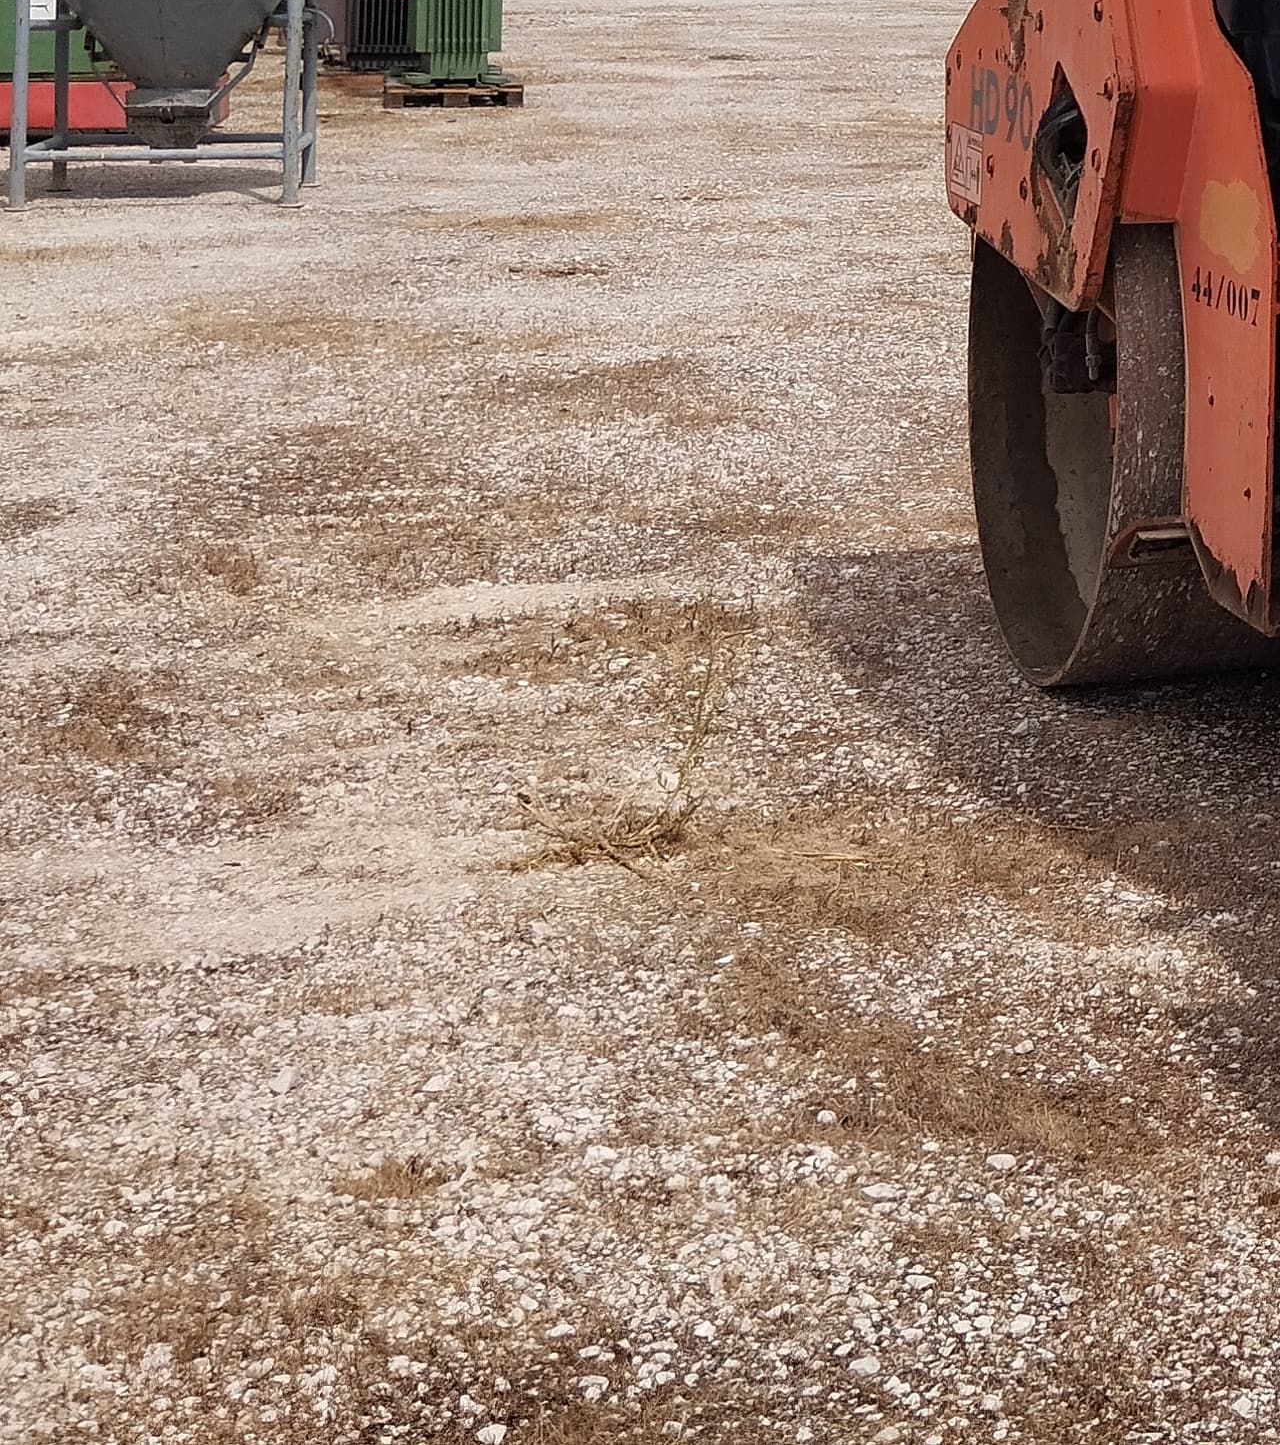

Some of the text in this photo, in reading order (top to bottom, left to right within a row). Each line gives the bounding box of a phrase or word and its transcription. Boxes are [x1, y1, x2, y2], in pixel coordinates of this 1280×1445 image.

[970, 64, 1034, 152] HD 90
[1192, 265, 1261, 328] 44/007
